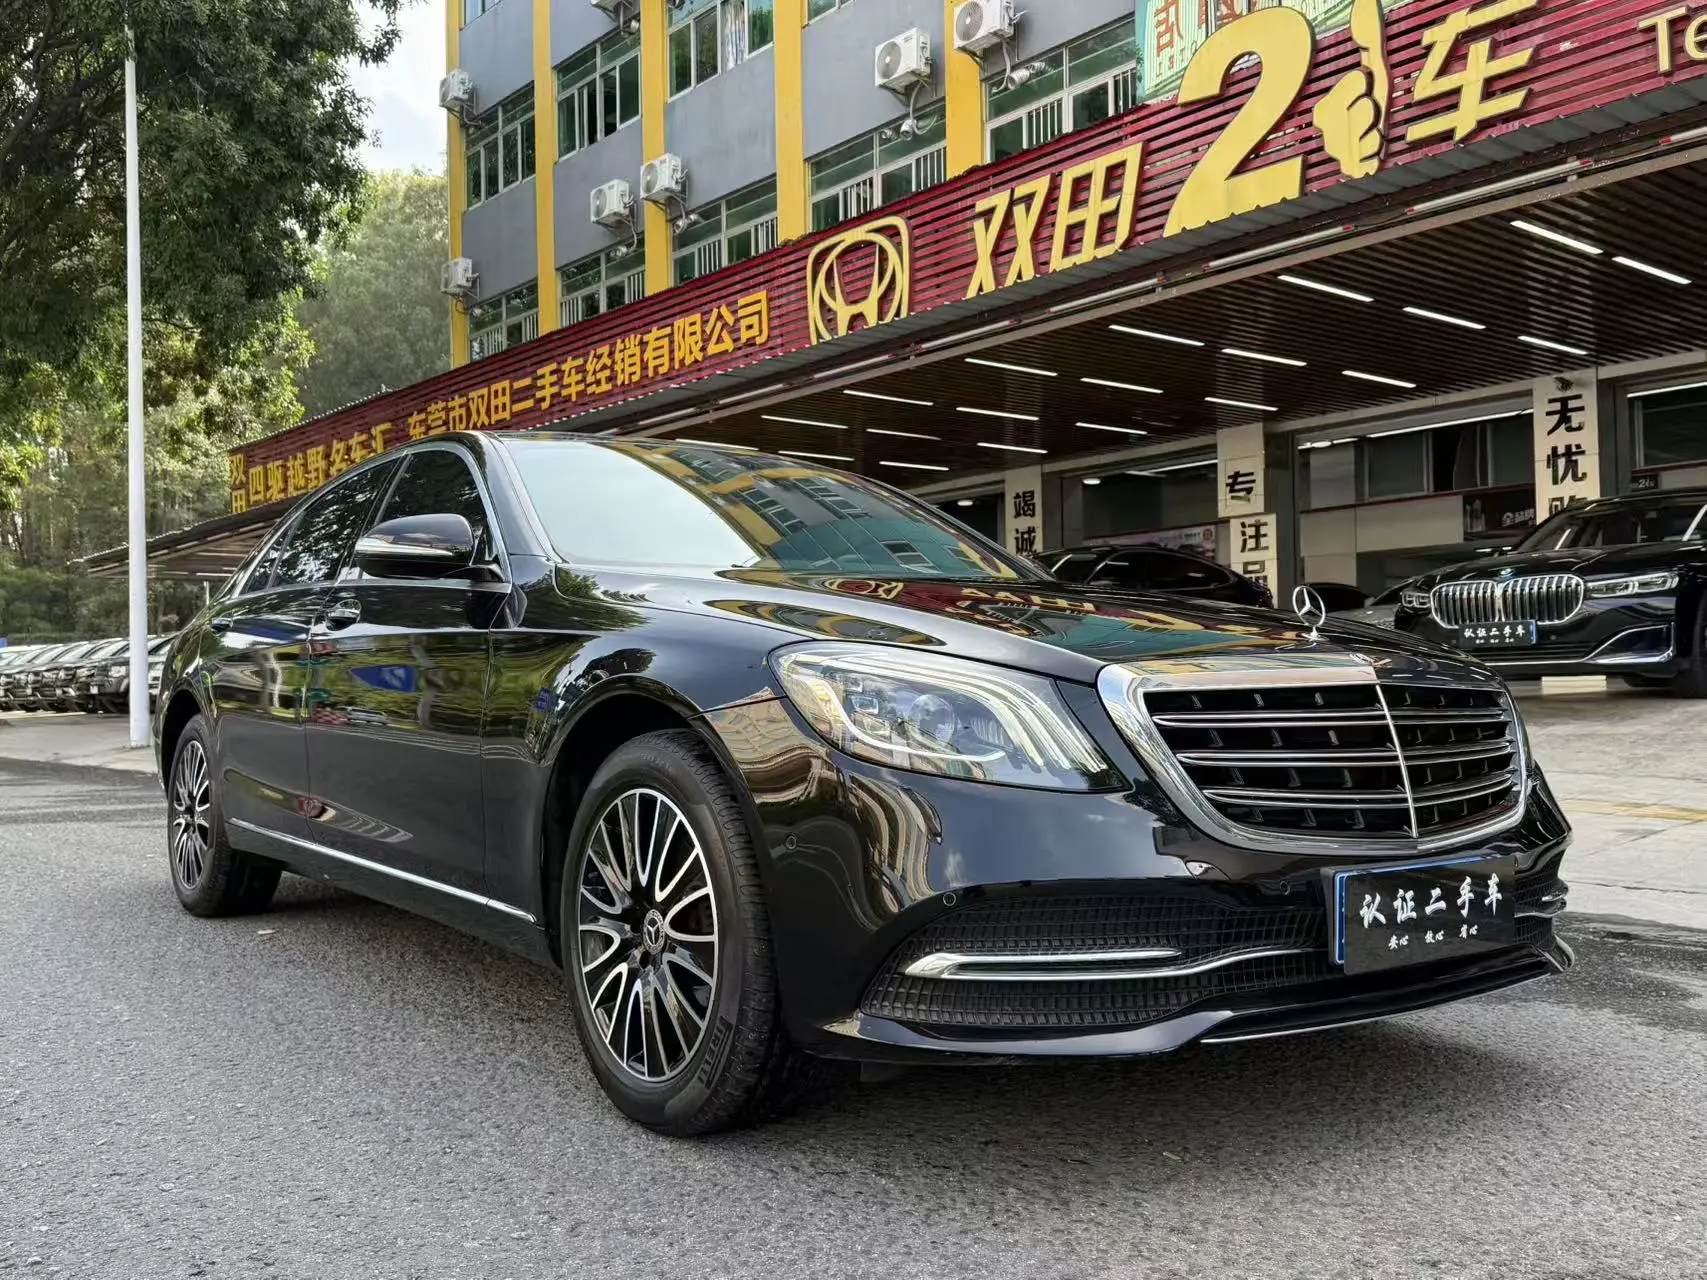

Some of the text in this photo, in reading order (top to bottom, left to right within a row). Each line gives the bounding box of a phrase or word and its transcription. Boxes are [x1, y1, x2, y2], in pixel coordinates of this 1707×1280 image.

[408, 291, 769, 439] 东莞市双田二手车经销有限公司
[1360, 873, 1503, 929] 认证二手车
